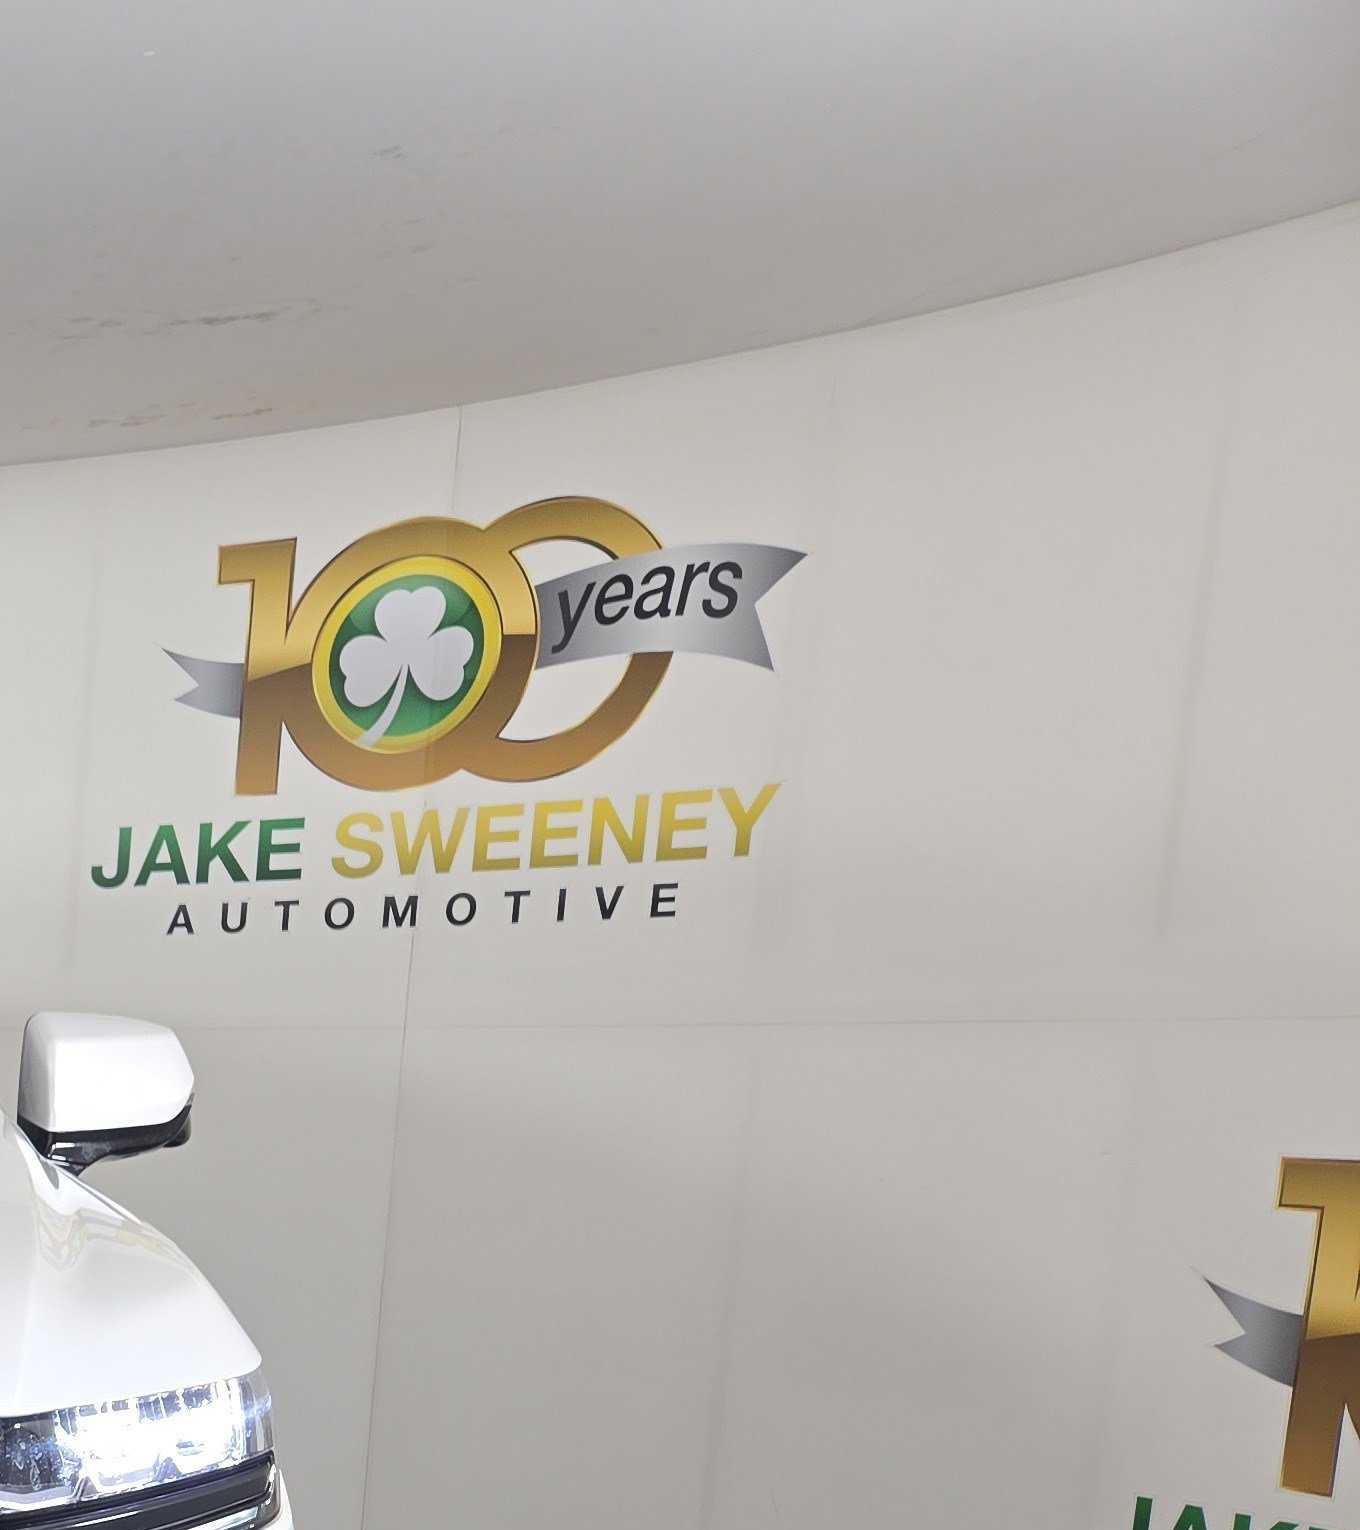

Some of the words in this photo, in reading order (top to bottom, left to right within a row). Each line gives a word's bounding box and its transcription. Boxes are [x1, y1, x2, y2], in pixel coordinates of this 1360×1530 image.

[216, 495, 674, 797] 100
[550, 558, 743, 656] years
[90, 816, 306, 889] JAKE
[330, 781, 781, 880] SWEENEY
[167, 882, 679, 936] AUTOMOTIVE
